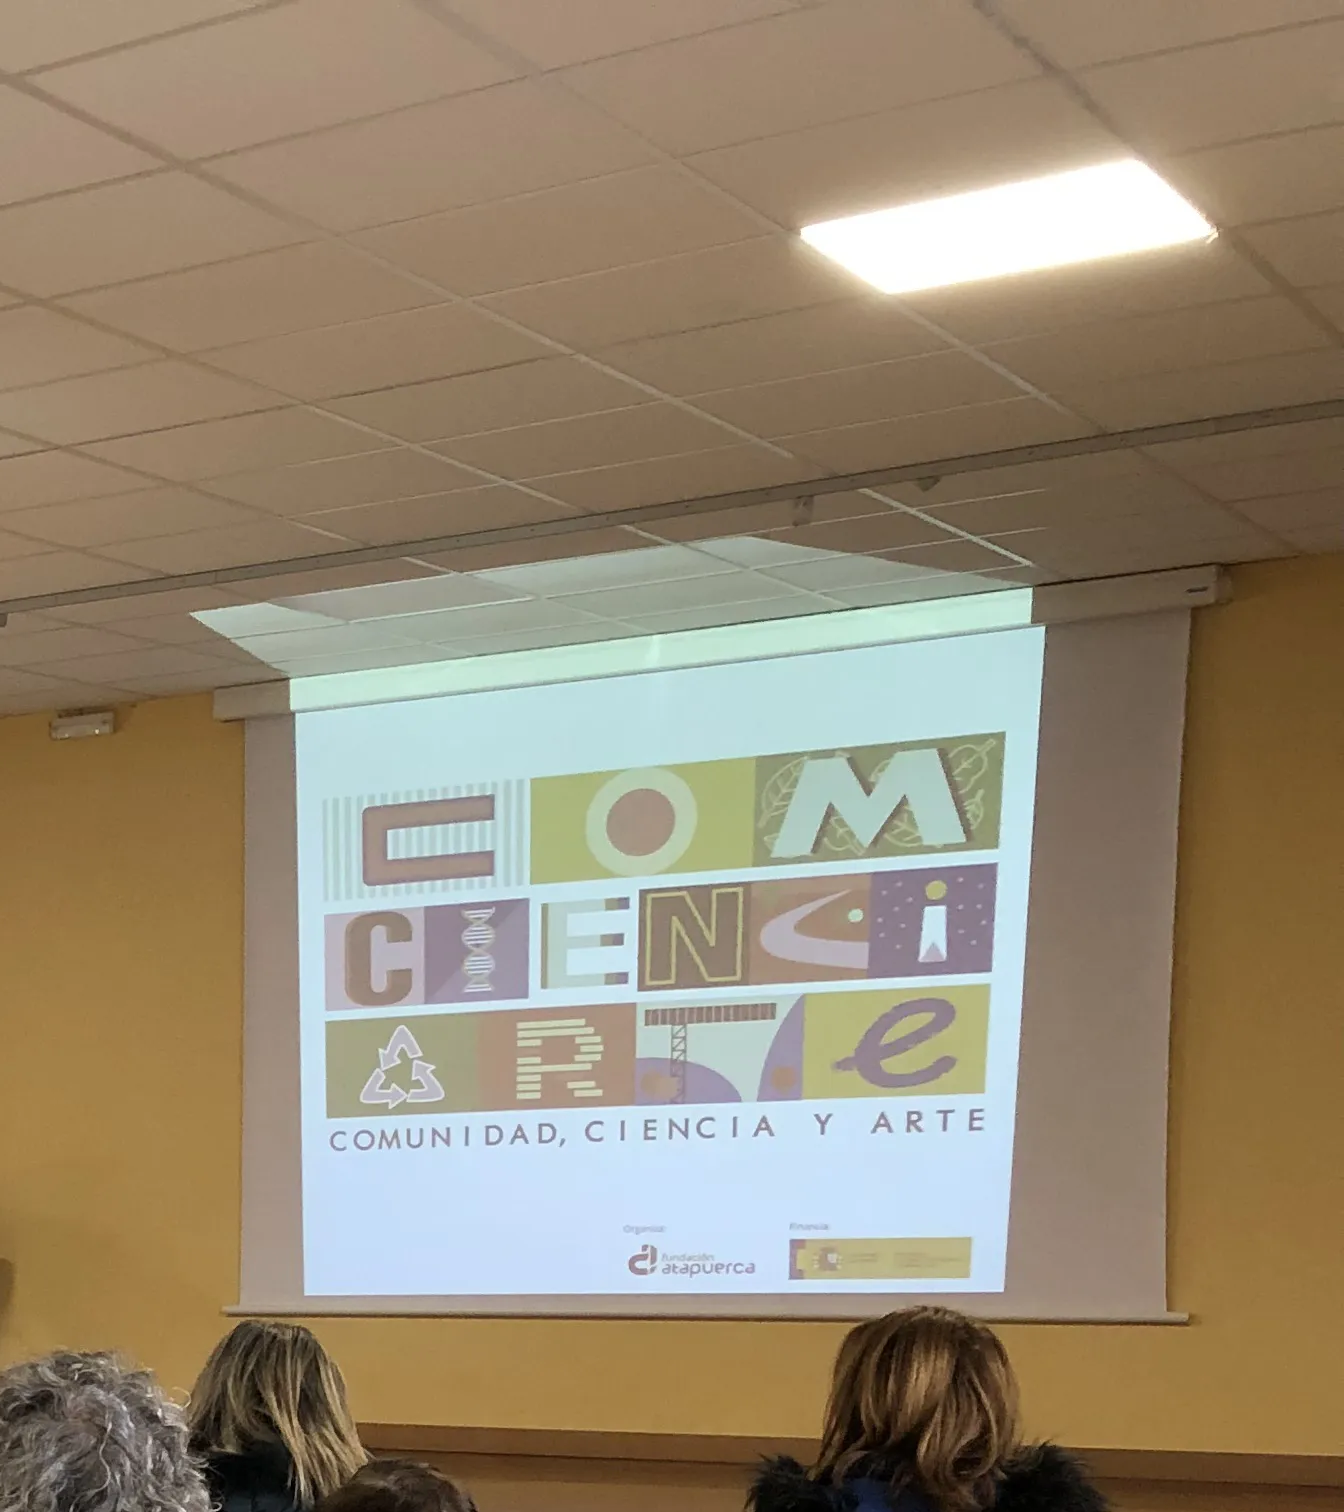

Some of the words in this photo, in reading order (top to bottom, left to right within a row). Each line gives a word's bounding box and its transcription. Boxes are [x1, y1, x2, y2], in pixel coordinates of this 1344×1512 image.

[362, 747, 970, 887] COM
[329, 1122, 567, 1152] COMUNIDAD,
[584, 1114, 776, 1144] CIENCIA
[813, 1112, 833, 1136] Y
[870, 1108, 986, 1135] ARTE
[661, 1262, 756, 1279] atapuerca
